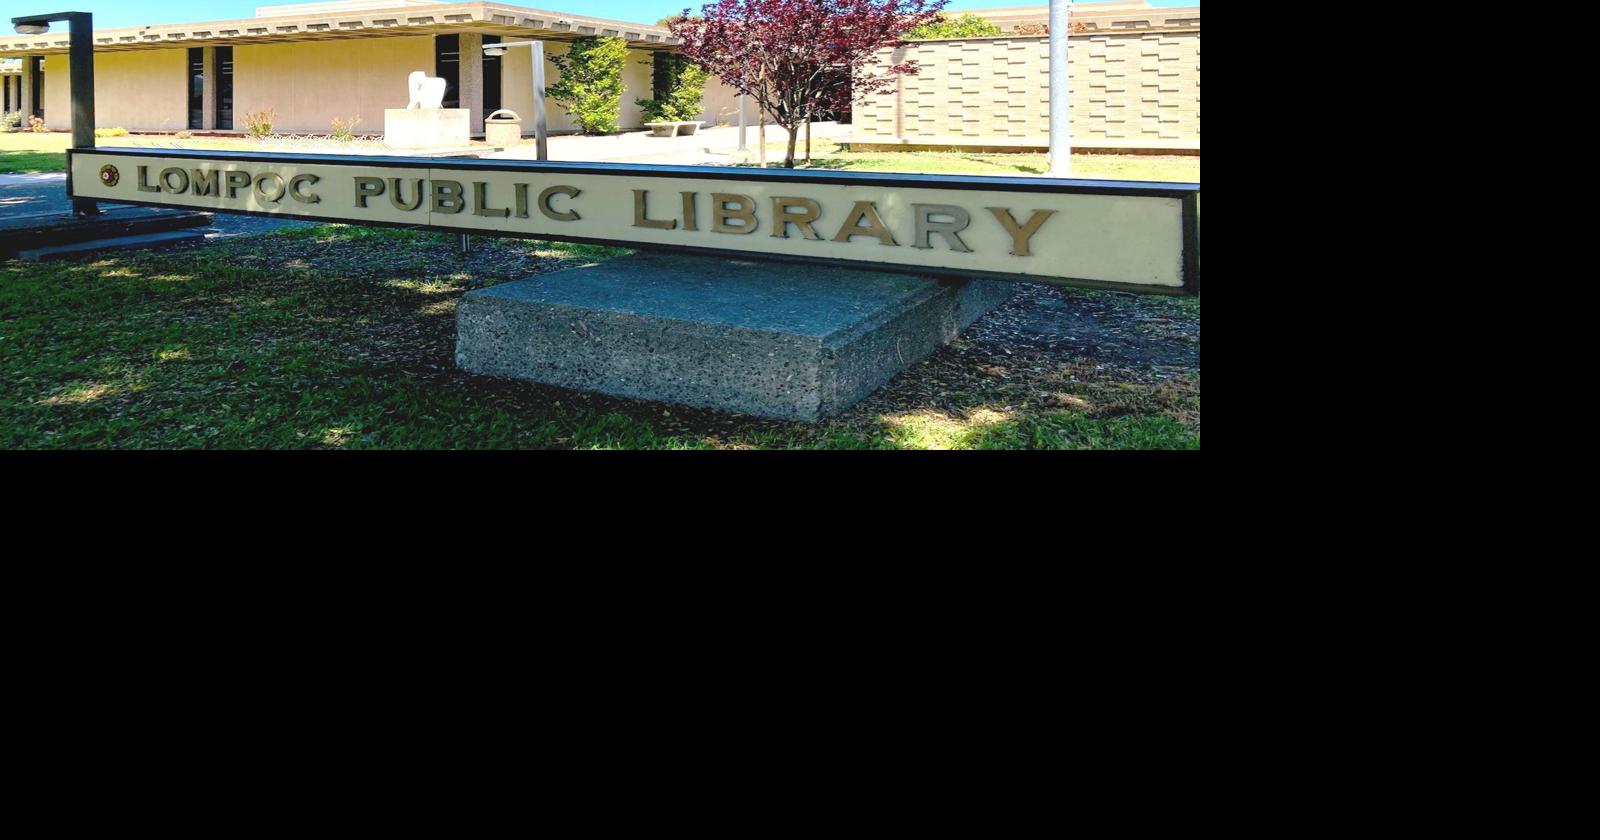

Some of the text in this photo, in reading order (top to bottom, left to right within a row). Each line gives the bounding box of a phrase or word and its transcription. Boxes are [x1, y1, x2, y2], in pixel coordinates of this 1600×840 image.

[137, 165, 1058, 256] LOMPOC PUBLIC LIBRARY
